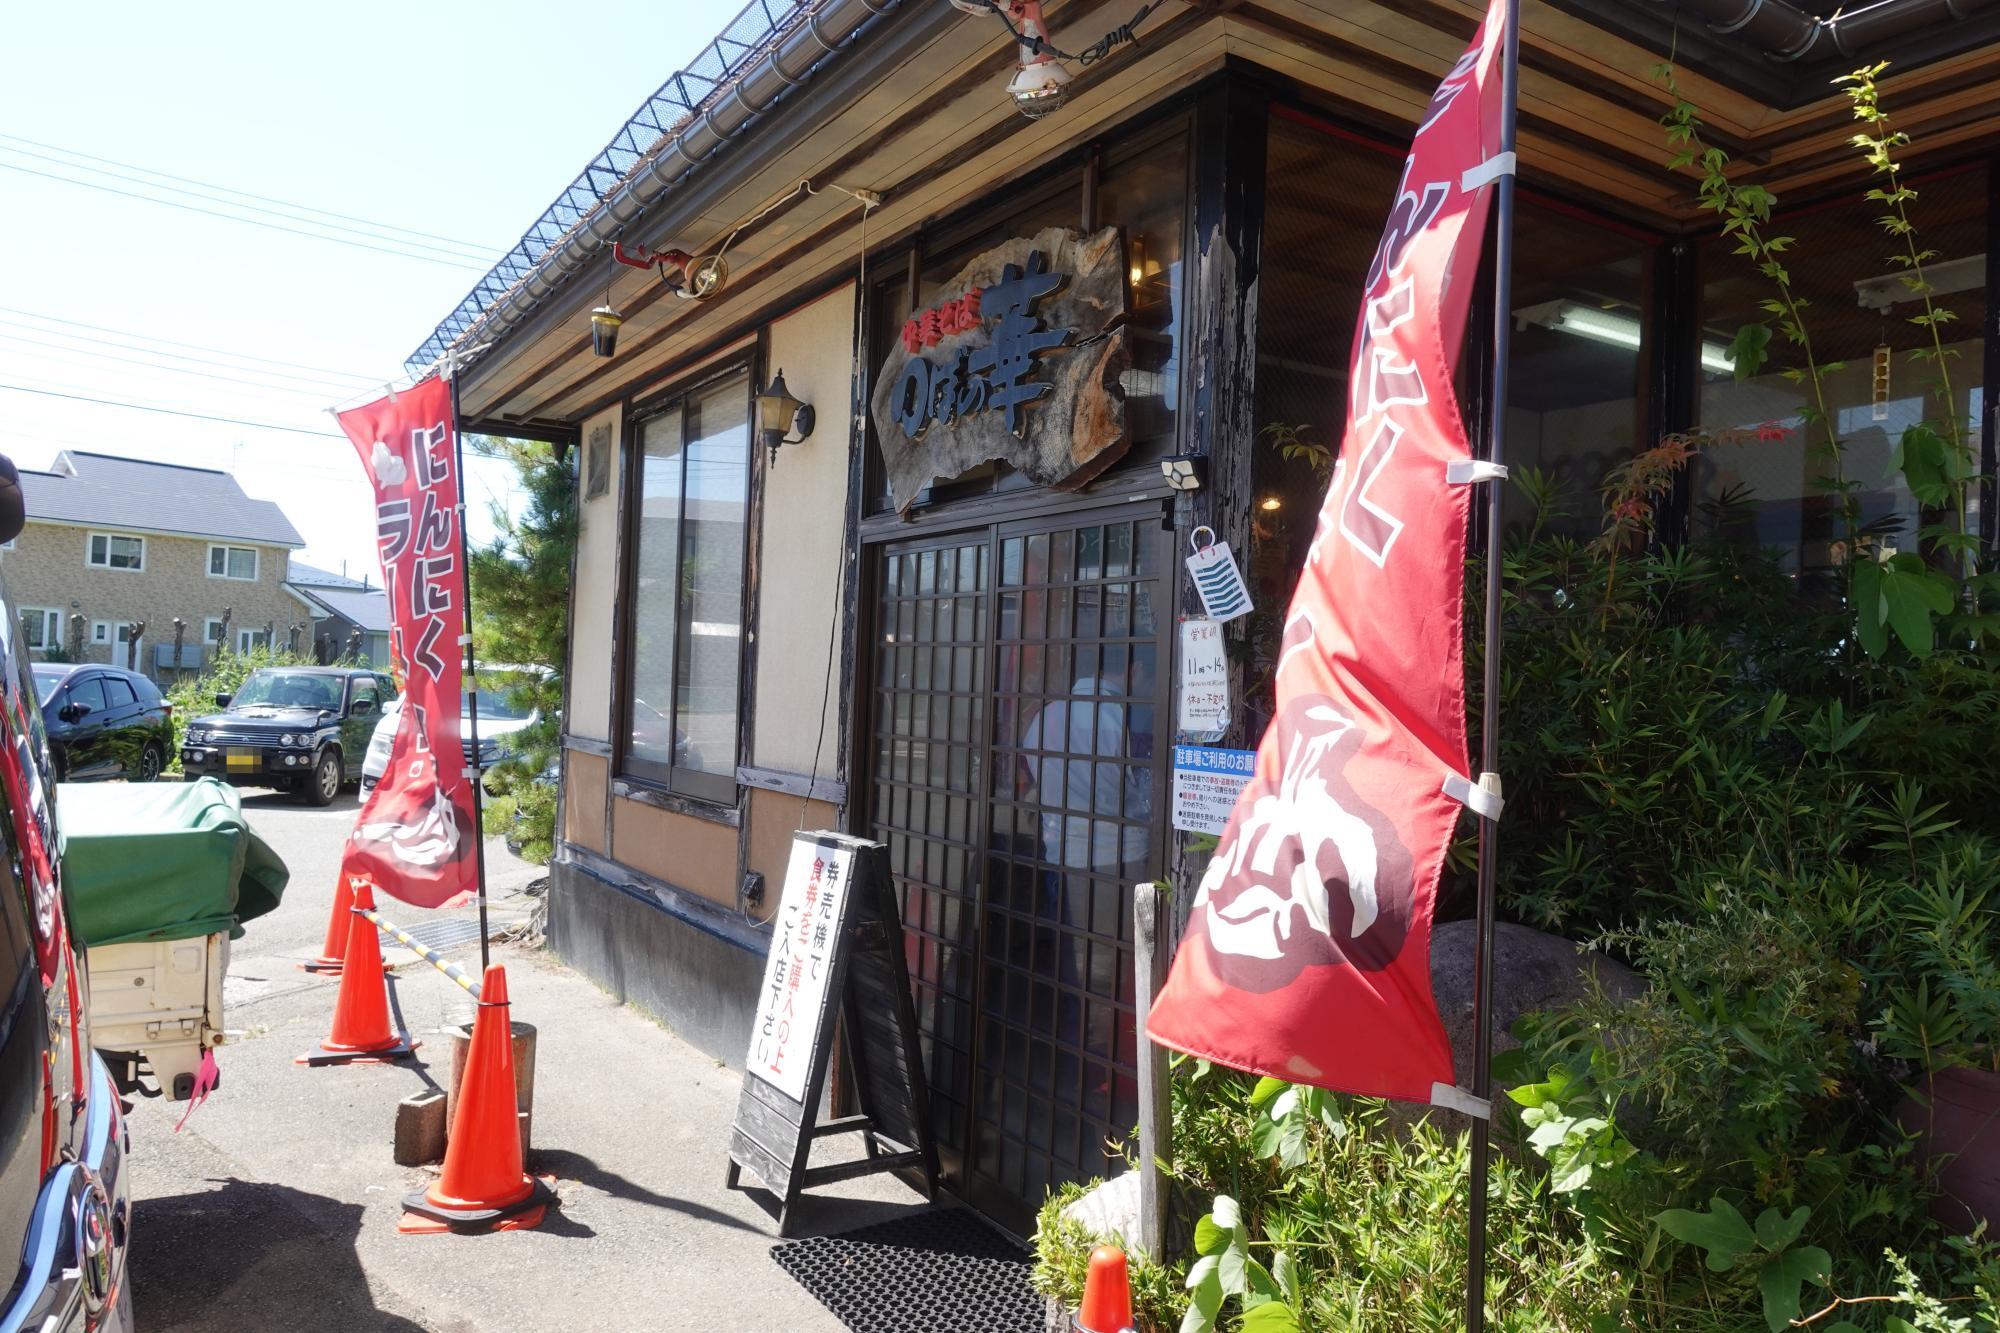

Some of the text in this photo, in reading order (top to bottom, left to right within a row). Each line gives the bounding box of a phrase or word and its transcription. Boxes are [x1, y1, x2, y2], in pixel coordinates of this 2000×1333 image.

[411, 421, 454, 683] にんにく
[810, 861, 840, 981] 券売機で
